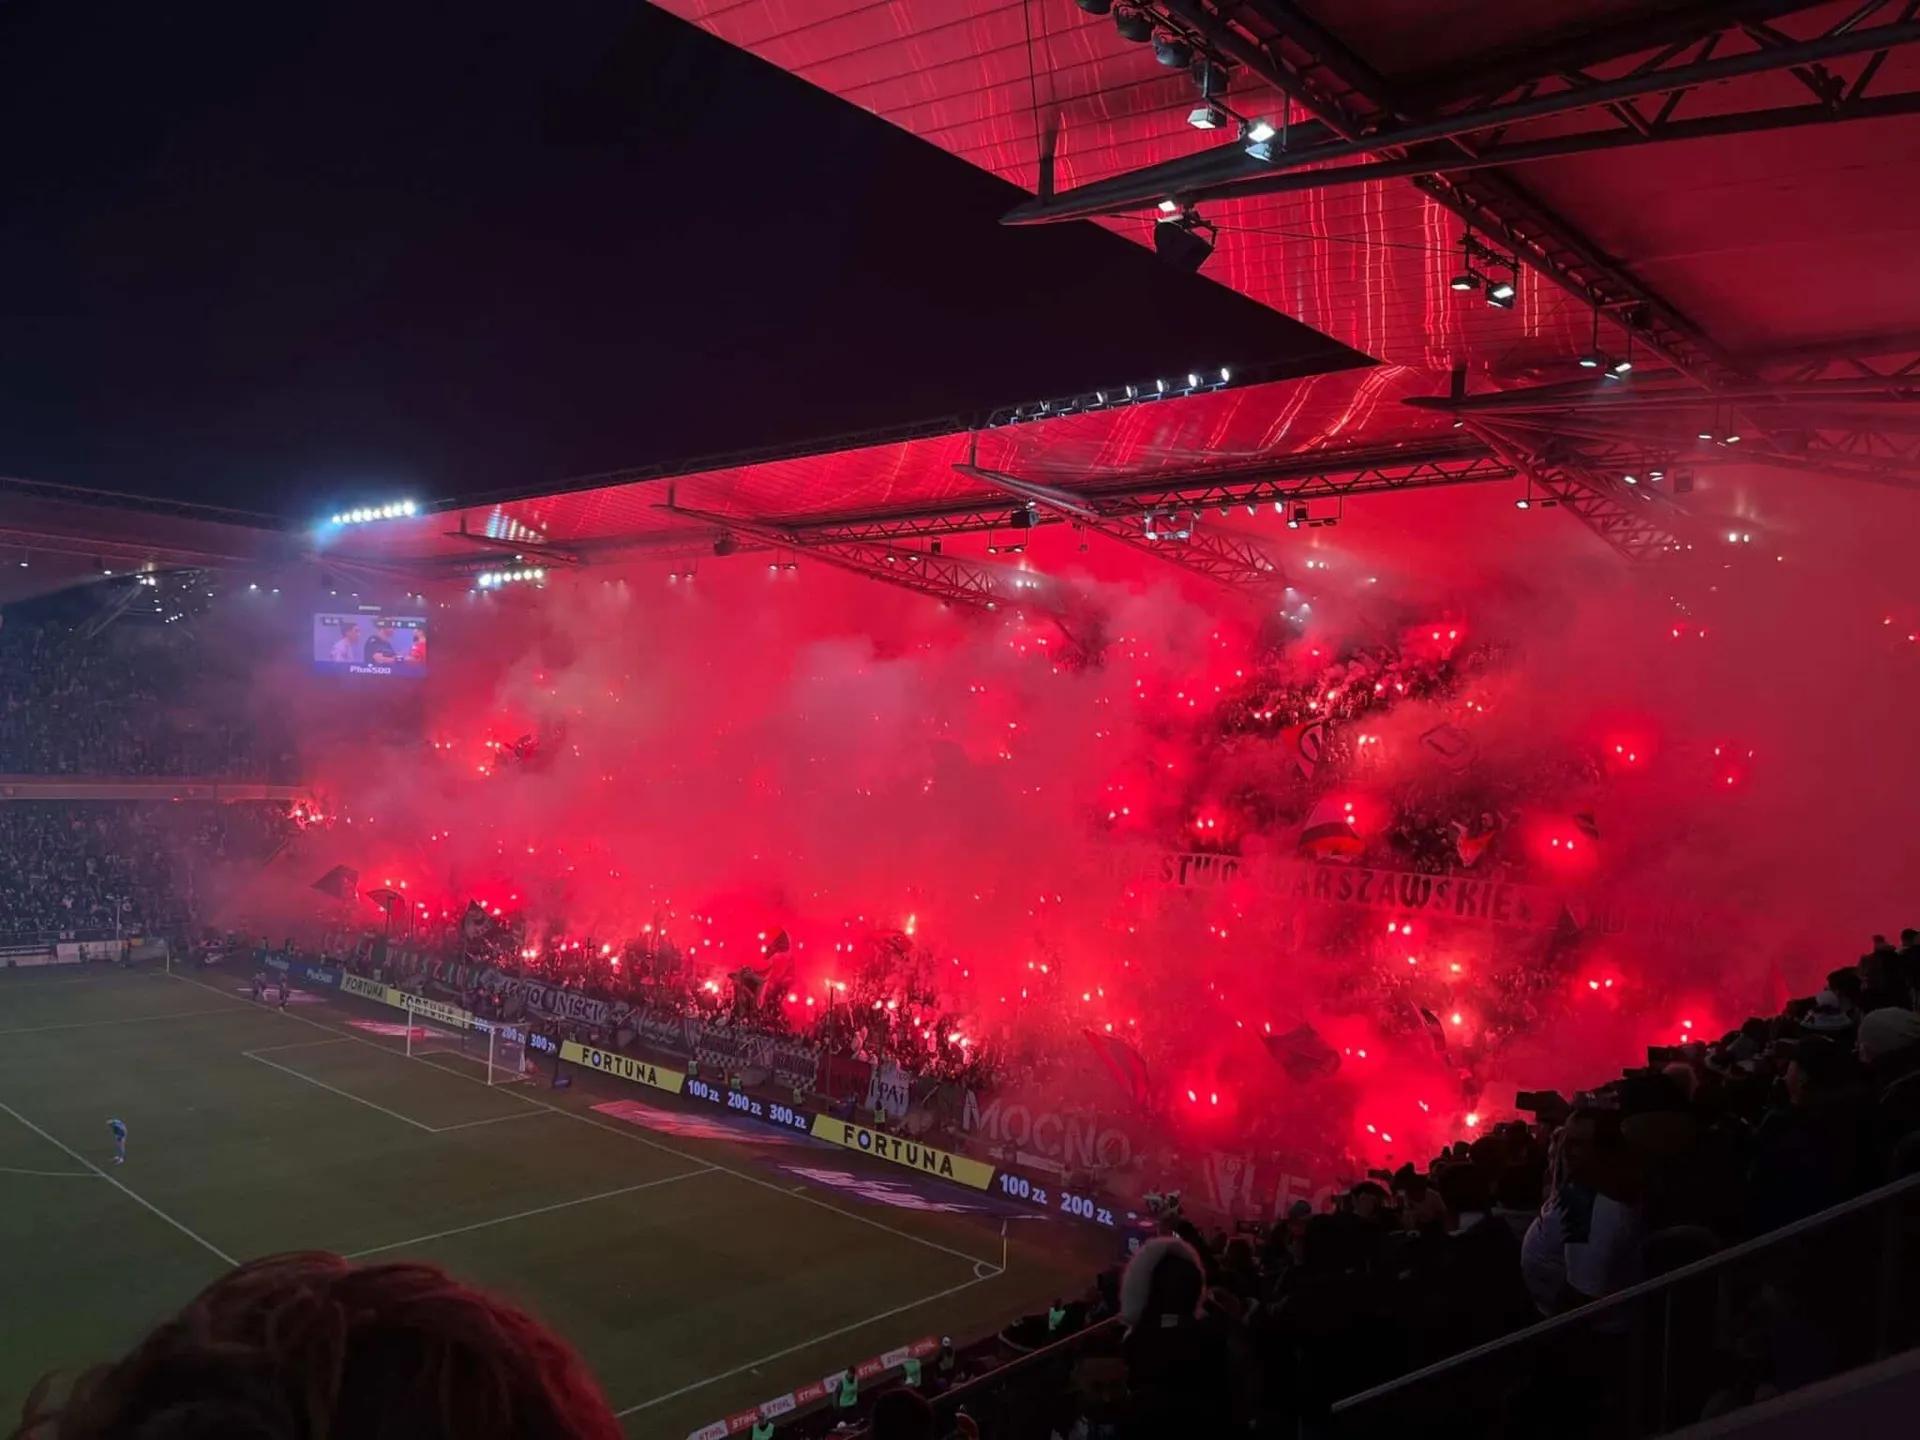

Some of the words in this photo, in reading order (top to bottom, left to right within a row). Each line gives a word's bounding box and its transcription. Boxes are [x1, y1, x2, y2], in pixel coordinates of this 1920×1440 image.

[350, 664, 391, 674] Plus500
[346, 976, 384, 998] FORTUNA
[531, 1033, 547, 1050] 300
[582, 1047, 657, 1085] FORTUNA
[688, 1079, 708, 1098] 100
[727, 1091, 749, 1111] 200
[769, 1104, 792, 1125] 300
[962, 1089, 1132, 1168] MOCNO
[843, 1124, 953, 1178] FORTUNA
[1000, 1173, 1030, 1199] 100
[1060, 1191, 1095, 1219] 200
[732, 1412, 759, 1430] STIHL
